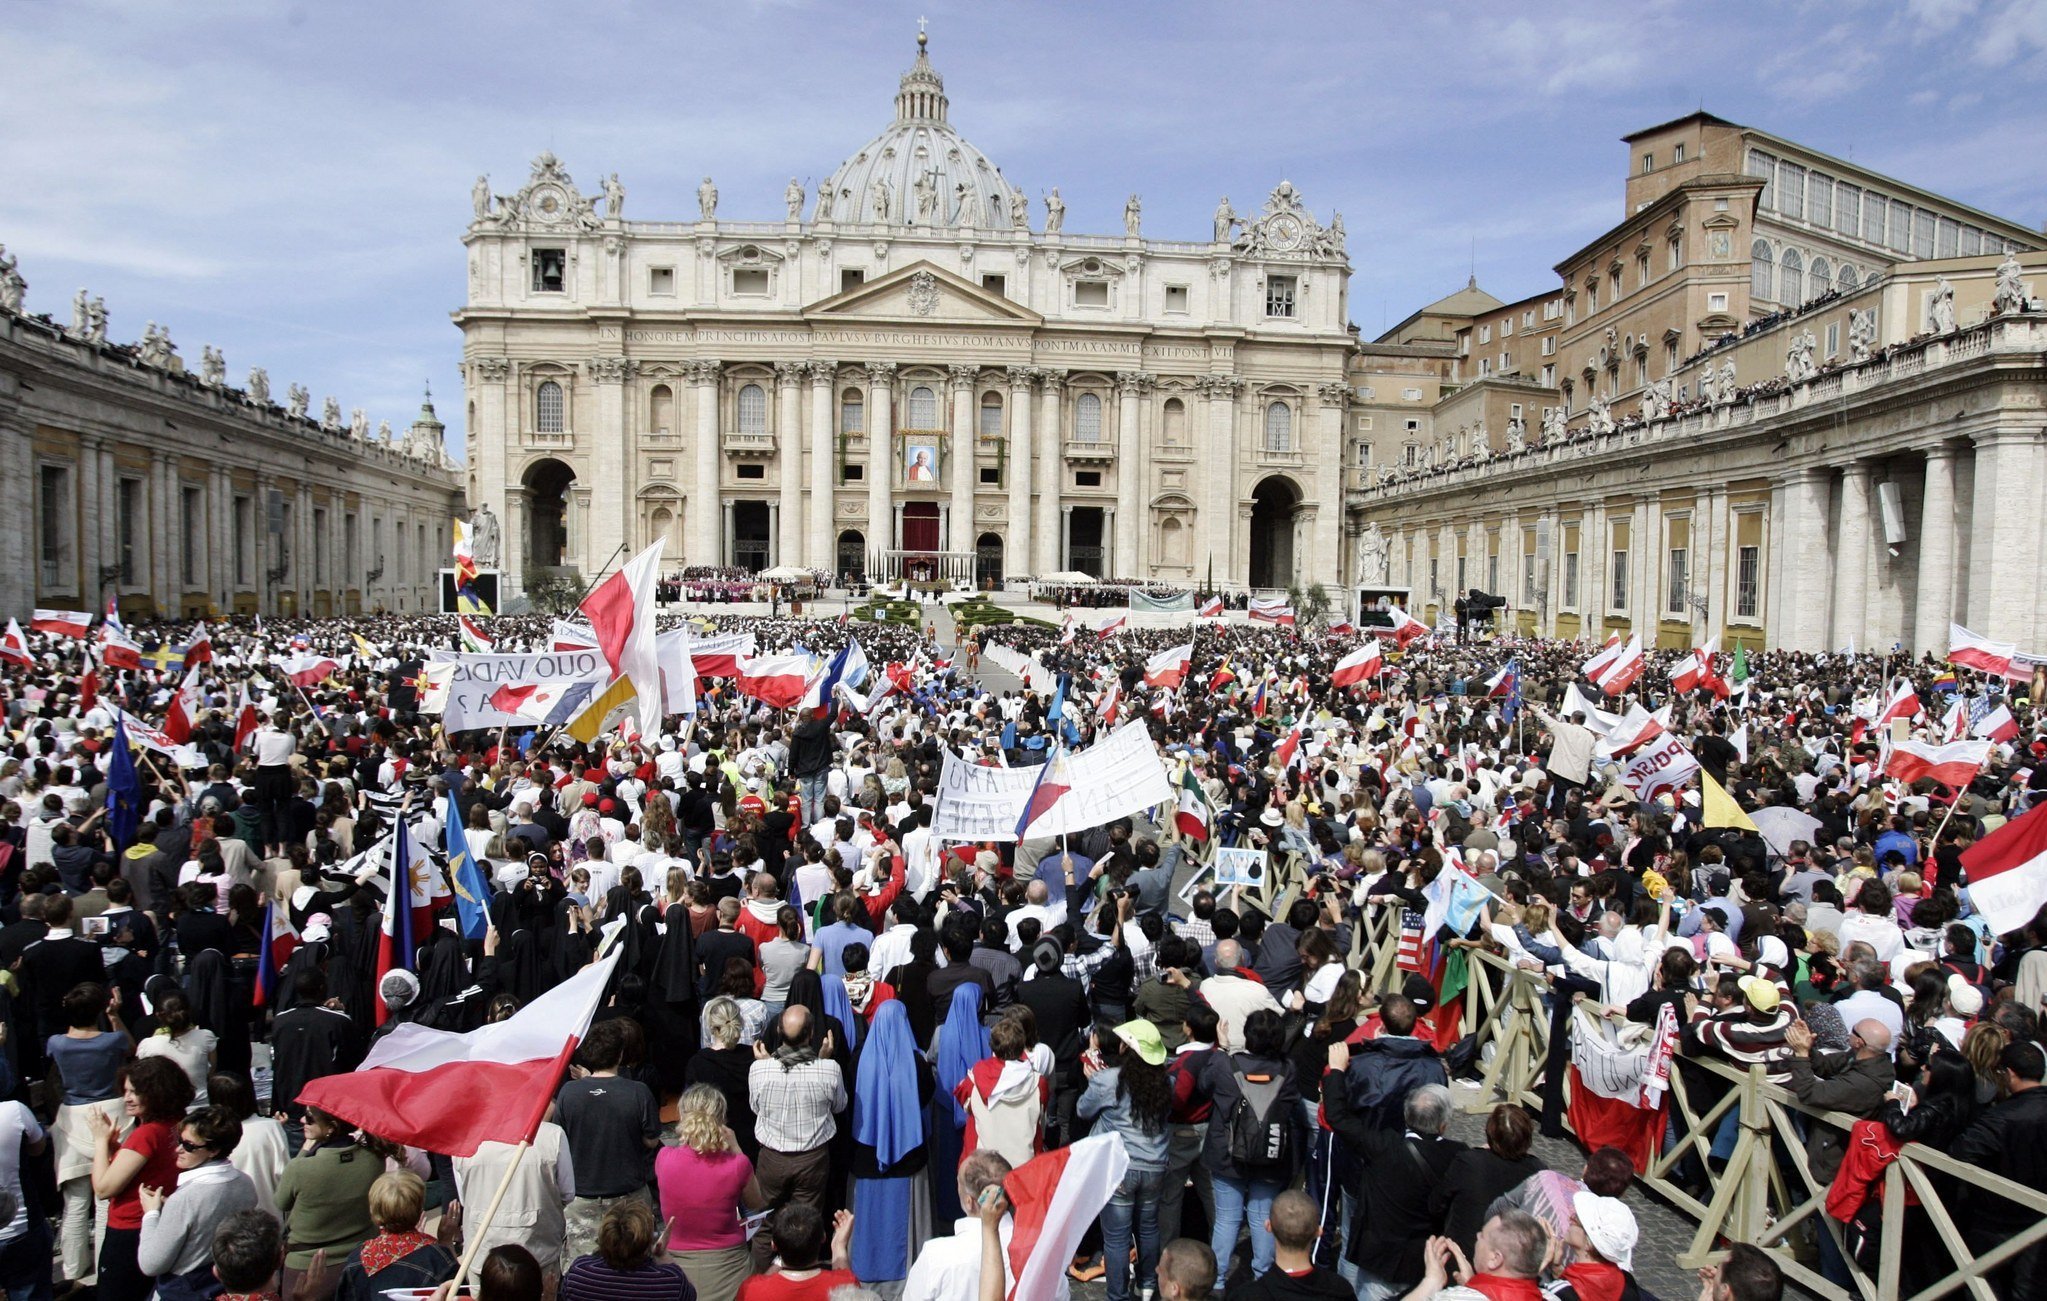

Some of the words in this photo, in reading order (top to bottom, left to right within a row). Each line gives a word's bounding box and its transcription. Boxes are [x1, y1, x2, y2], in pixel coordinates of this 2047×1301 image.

[600, 328, 616, 339] IN
[624, 330, 695, 342] HONOREM
[698, 330, 768, 342] PRINCIPIS
[770, 332, 813, 343] APOST
[814, 331, 860, 343] PAVLVS
[874, 334, 959, 346] BVRGHESIVS
[962, 336, 1031, 348] ROMANVS
[1213, 347, 1232, 358] VII
[1267, 1123, 1280, 1159] SLAM
